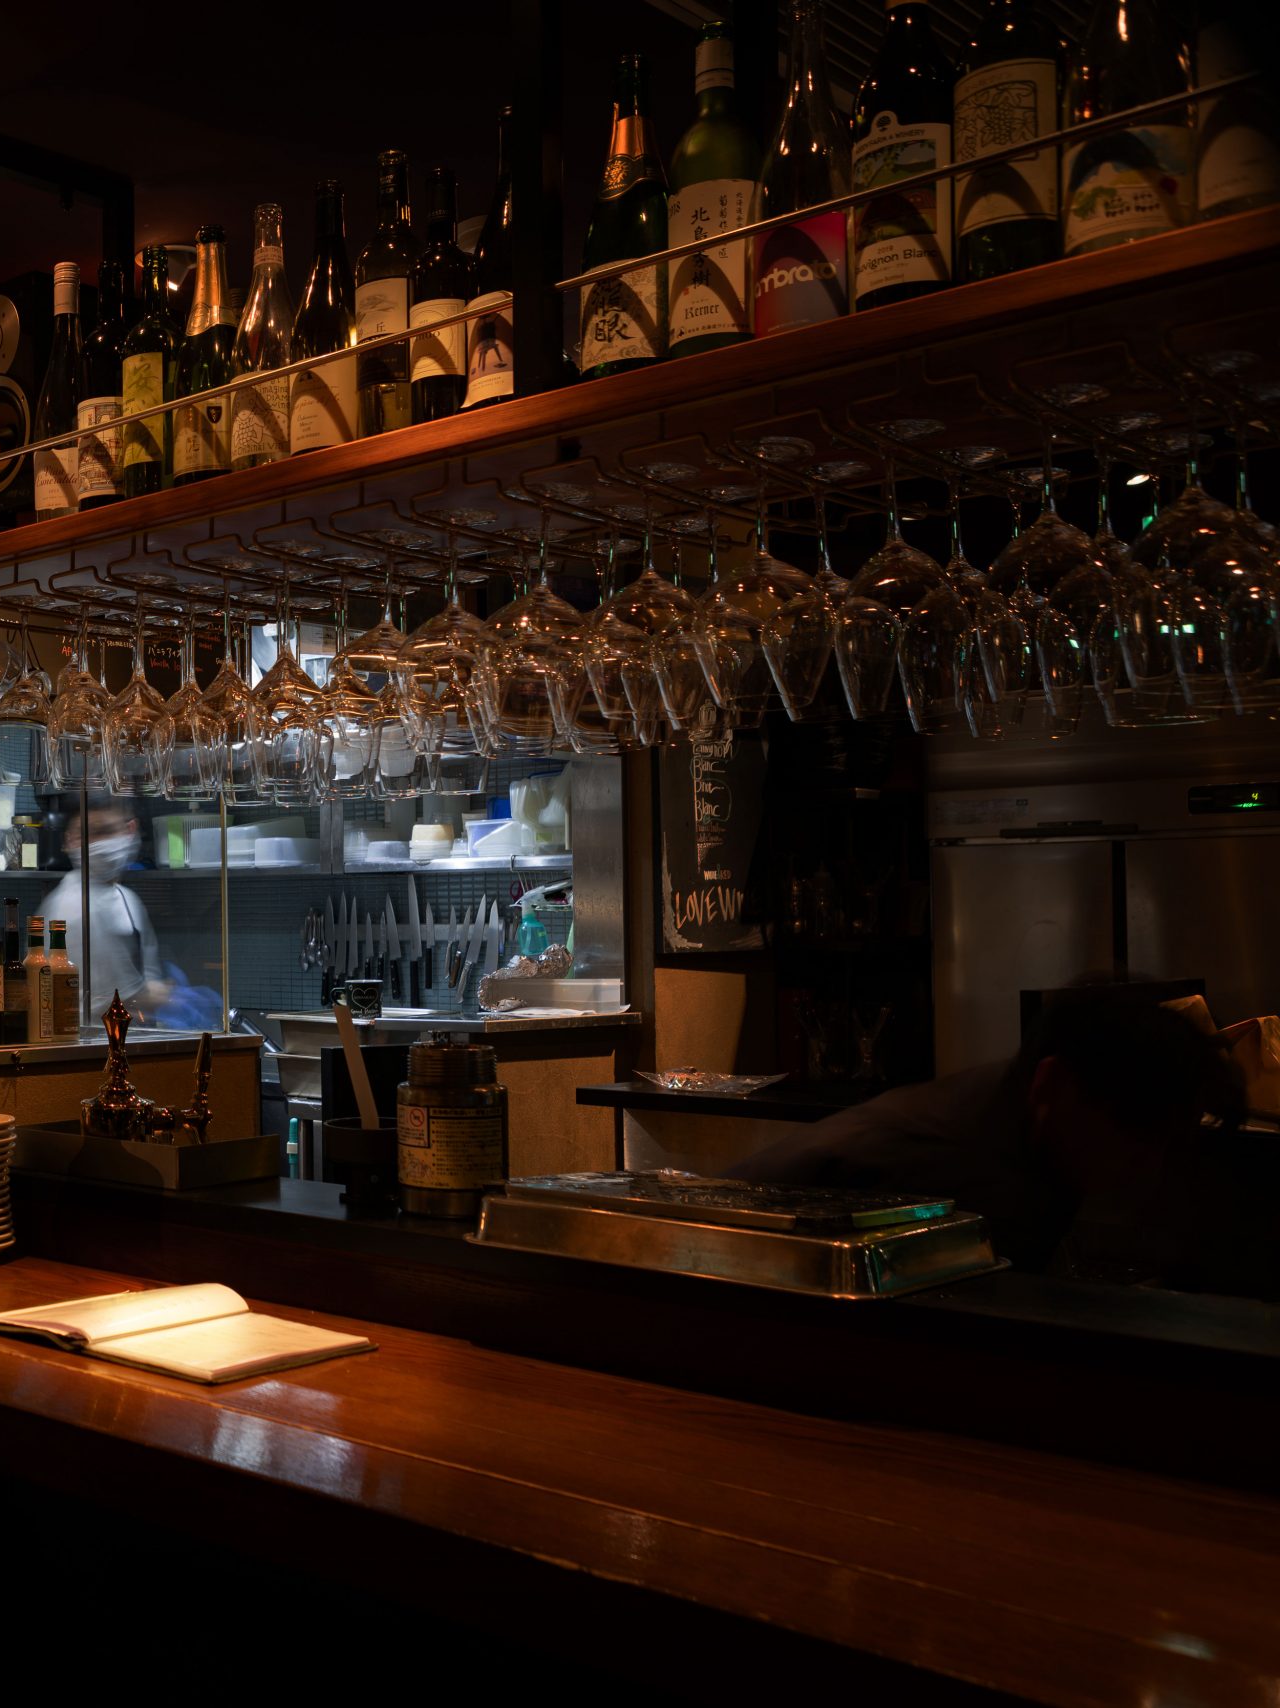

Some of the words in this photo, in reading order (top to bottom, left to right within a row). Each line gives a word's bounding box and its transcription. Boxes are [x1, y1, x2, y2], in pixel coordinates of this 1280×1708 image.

[903, 246, 938, 262] Blanc
[685, 304, 720, 319] Kerner
[676, 886, 718, 929] LOVE
